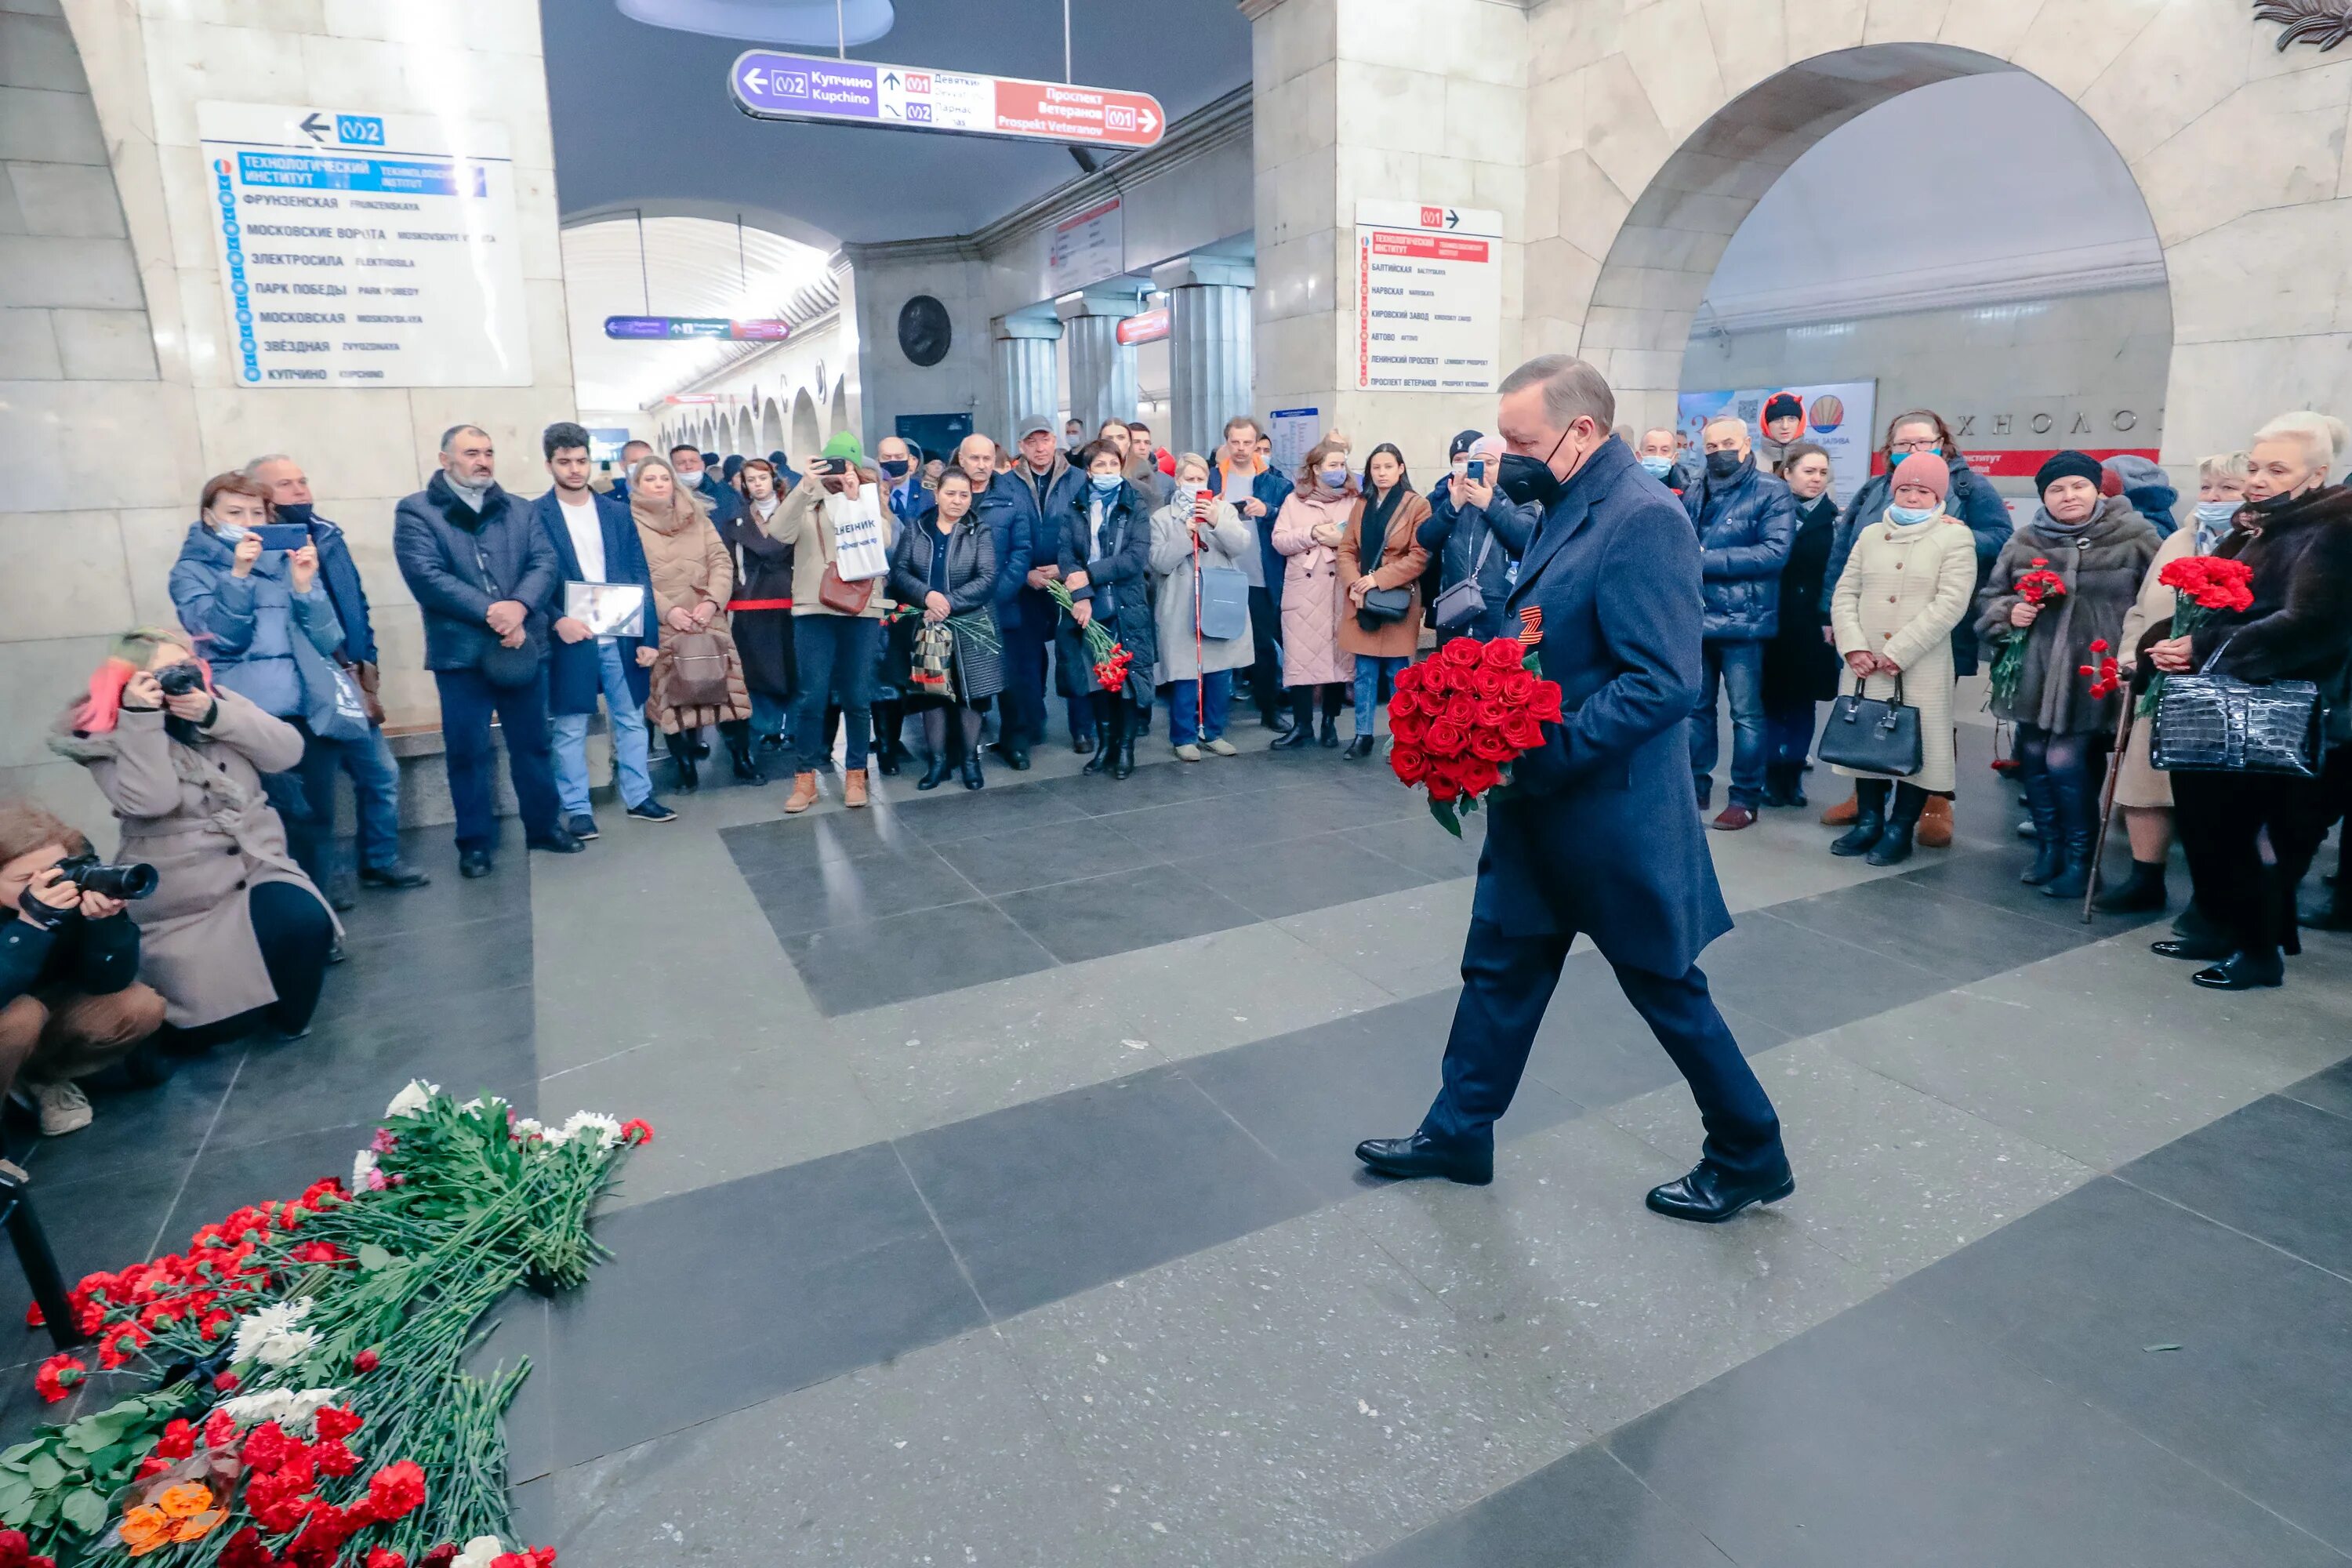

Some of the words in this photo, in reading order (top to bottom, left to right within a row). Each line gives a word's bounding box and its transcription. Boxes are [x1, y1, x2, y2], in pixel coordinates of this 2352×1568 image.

[811, 71, 873, 89] Купчино
[812, 89, 870, 104] Kupchino
[1046, 87, 1103, 105] Проспект
[1038, 101, 1103, 119] Ветеранов
[998, 115, 1046, 131] Prospekt
[1047, 120, 1103, 136] Veteranov
[243, 155, 370, 174] ТЕХНОЛОГИЧЕСКИЙ
[245, 170, 313, 184] ИНСТИТУТ
[243, 194, 338, 208] ФРУНЗЕНСКАЯ
[247, 224, 333, 238] МОСКОВСКИЕ
[251, 253, 344, 267] ЭЛЕКТРОСИЛА
[1372, 263, 1412, 274] БАЛТИЙСКАЯ
[256, 283, 289, 294] ПАРК
[293, 284, 347, 296] ПОБЕДЫ
[1371, 287, 1403, 296] НАРВСКАЯ
[260, 312, 346, 323] МОСКОВСКАЯ
[1371, 310, 1407, 319] КИРОВСКИЙ
[1410, 312, 1429, 321] ЗАВОД
[1371, 332, 1395, 341] АВТОВО
[264, 339, 330, 353] ЗВЁЗДНАЯ
[1371, 355, 1407, 364] ЛЕНИНСКИЙ
[267, 369, 327, 379] КУПЧИНО
[1371, 378, 1402, 387] ПРОСПЕКТ
